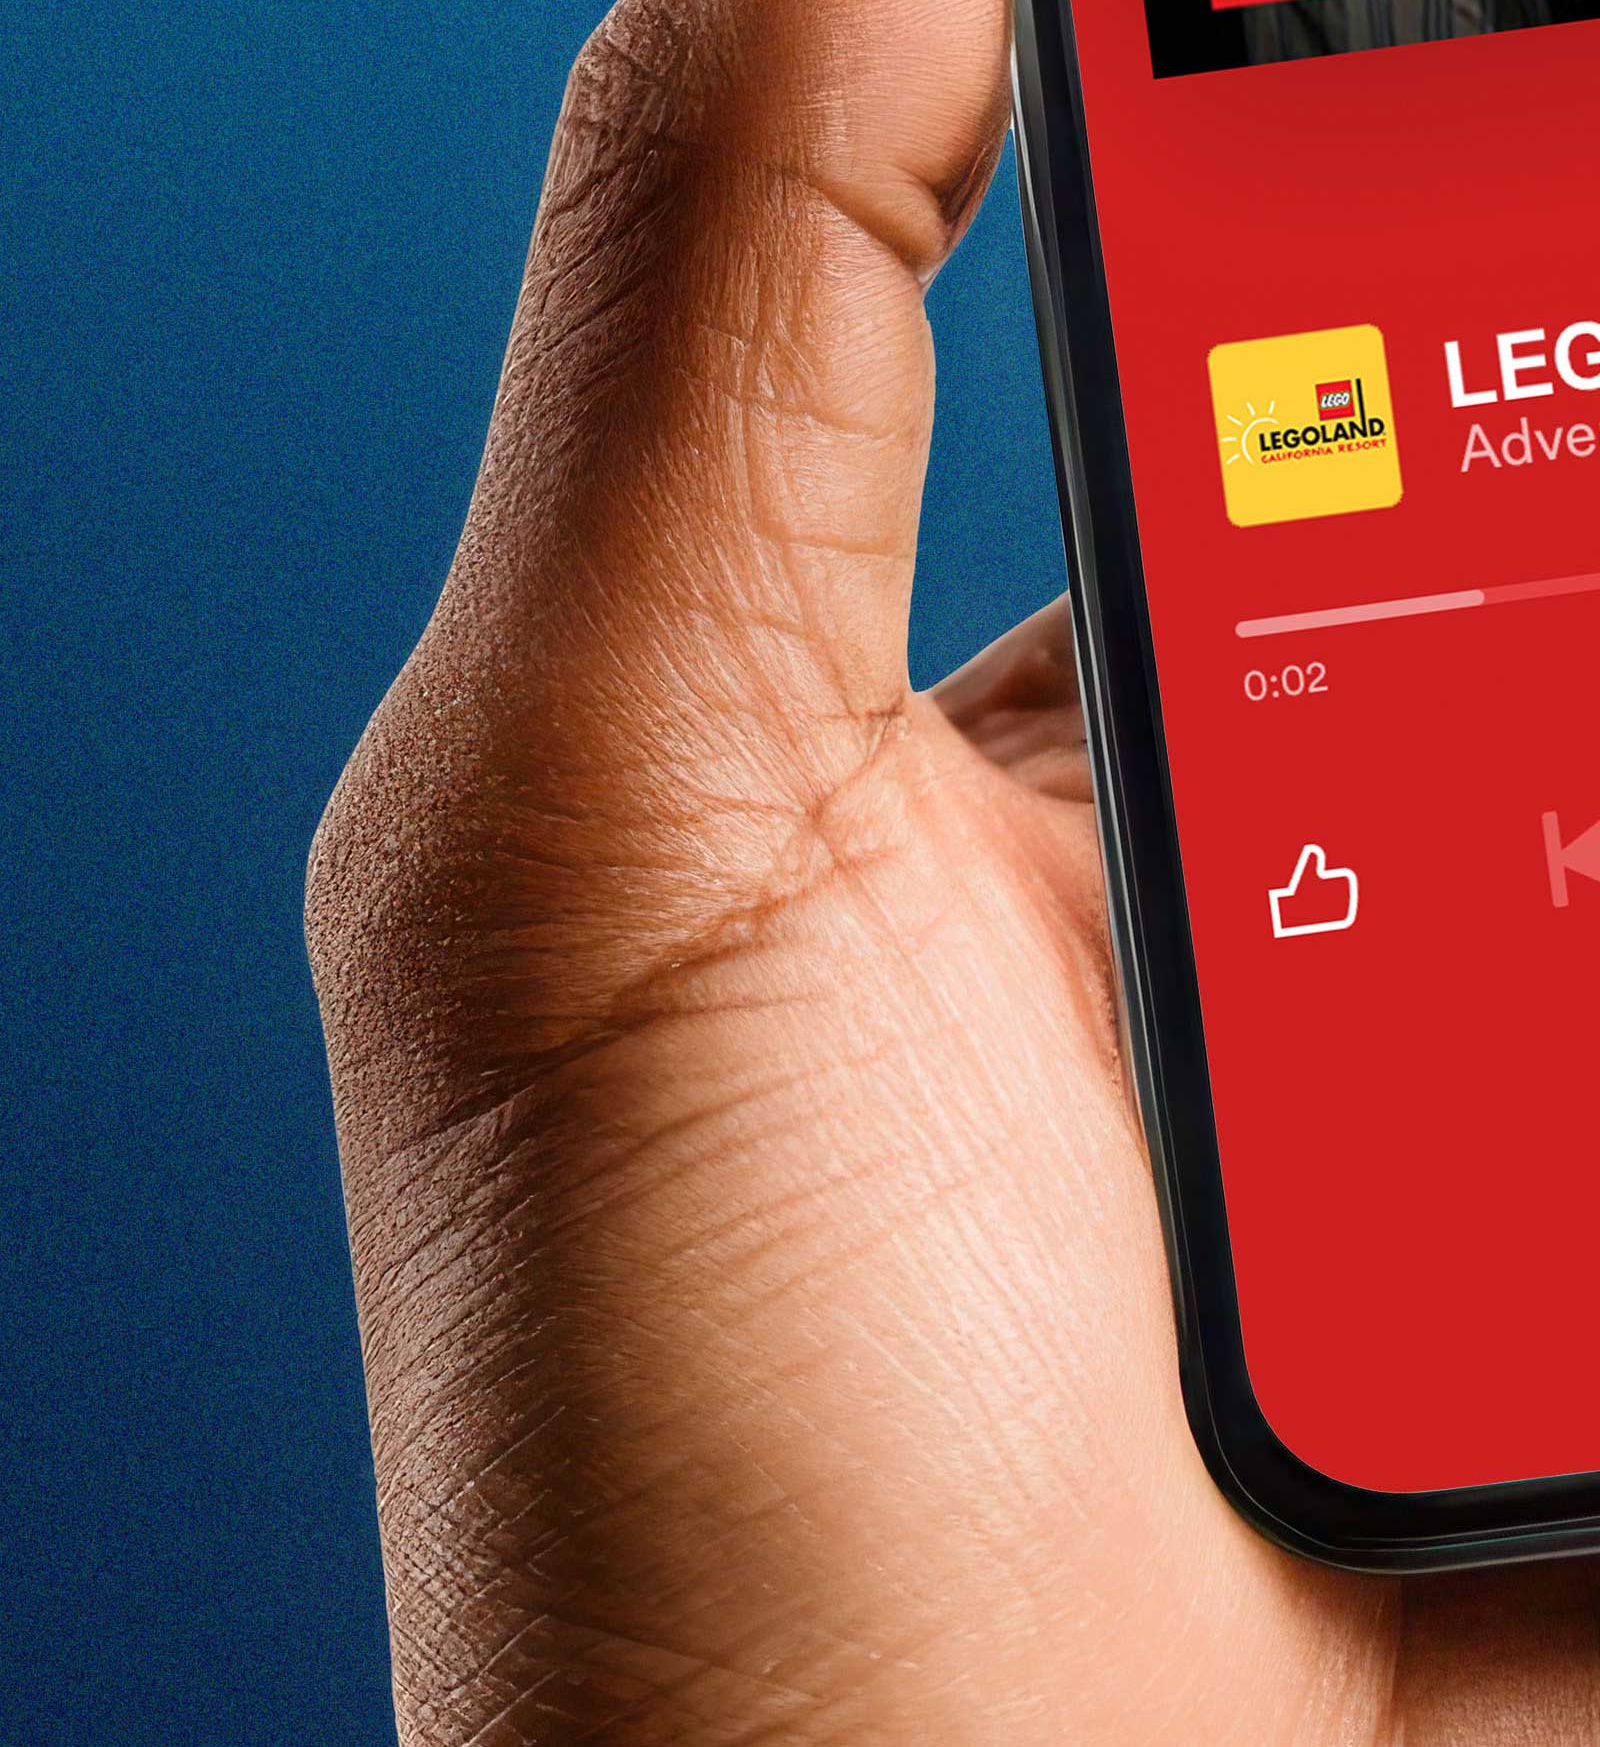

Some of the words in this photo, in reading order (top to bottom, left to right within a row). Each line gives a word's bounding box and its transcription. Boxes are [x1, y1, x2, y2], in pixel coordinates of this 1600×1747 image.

[1320, 391, 1350, 409] LEGO
[1261, 447, 1334, 464] CALIFORNIA
[1337, 438, 1387, 452] RESORT
[1244, 661, 1329, 701] 0:02
